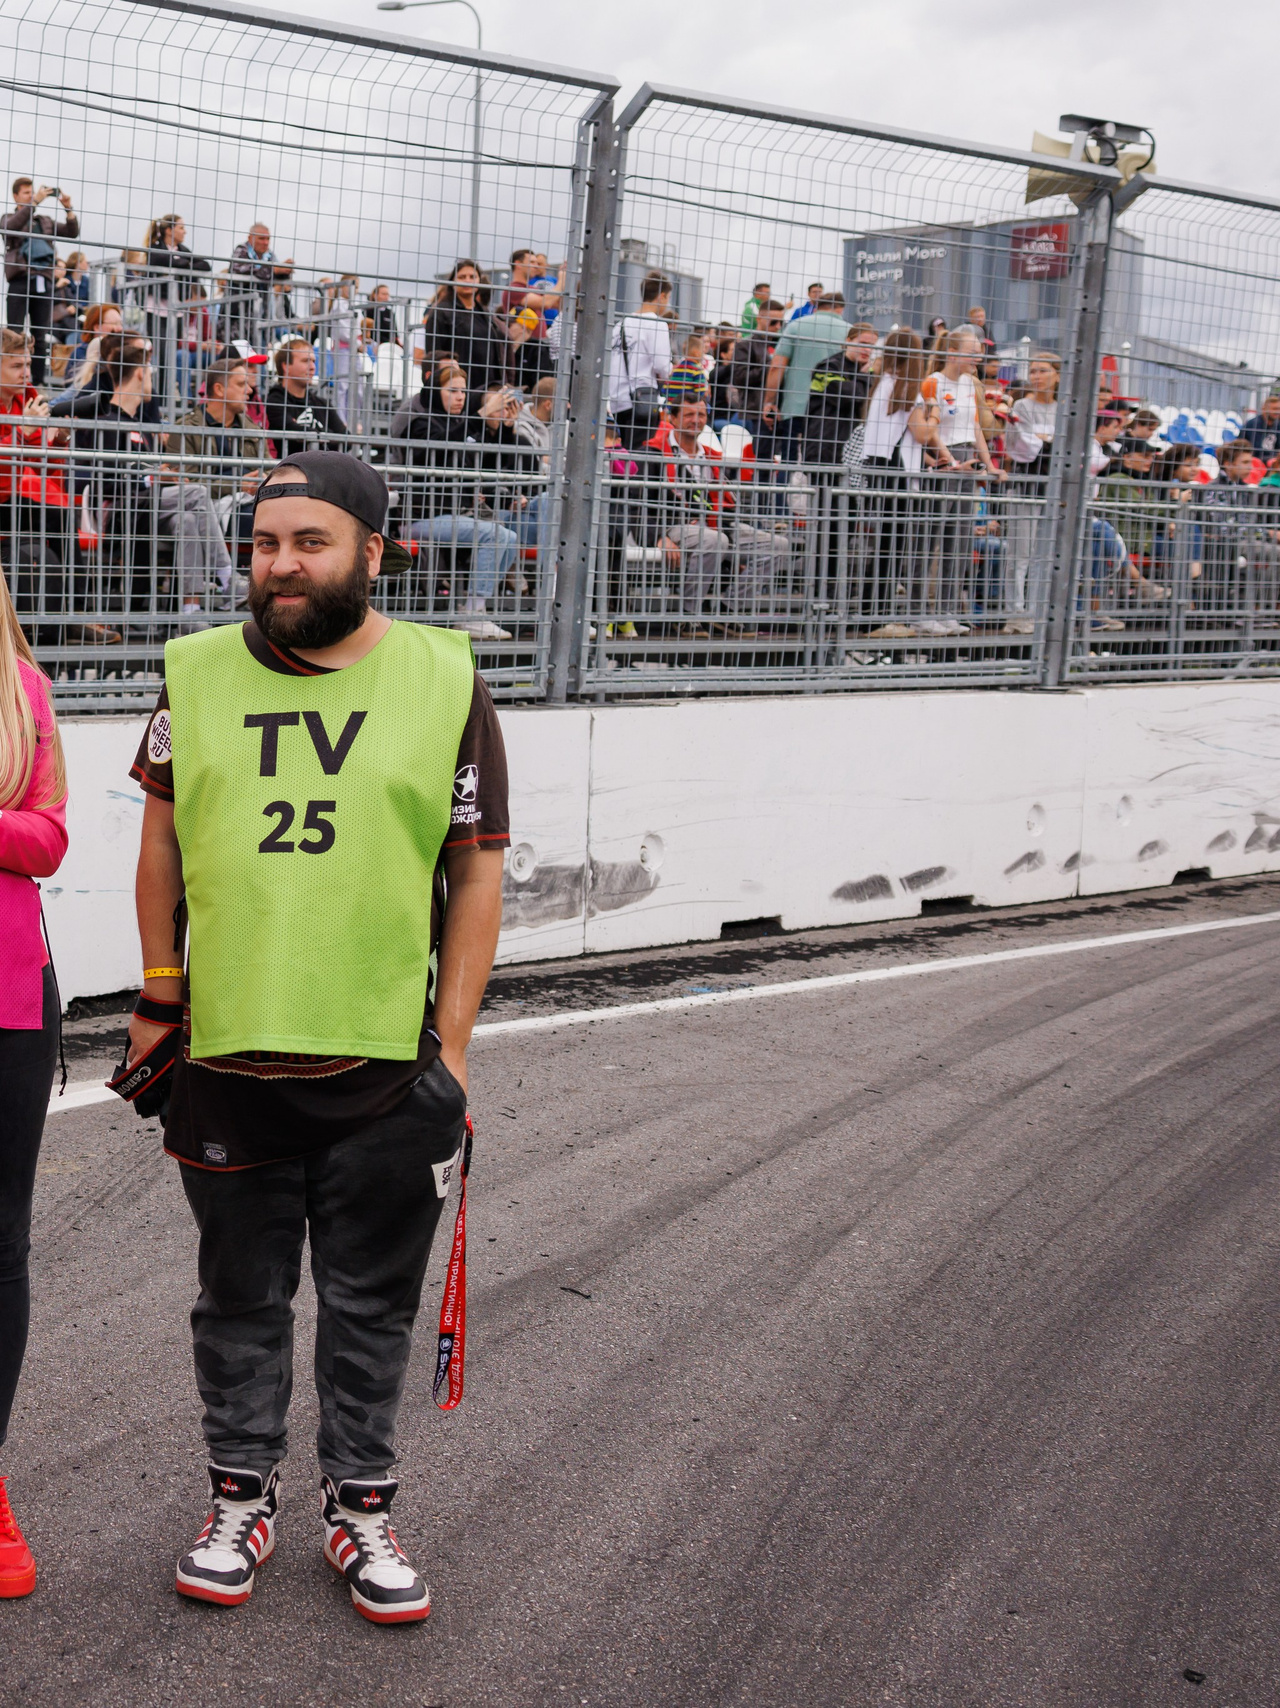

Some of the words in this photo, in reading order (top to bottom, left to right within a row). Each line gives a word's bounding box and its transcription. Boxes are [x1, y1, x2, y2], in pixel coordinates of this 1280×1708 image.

[856, 250, 901, 264] Ралли
[856, 267, 903, 282] Центр
[856, 287, 889, 302] Rally
[244, 710, 368, 777] TV
[258, 800, 336, 854] 25
[117, 1066, 151, 1095] Canon
[454, 1239, 463, 1259] ЭТО
[444, 1260, 459, 1326] ПРАКТИЧНО!
[452, 1340, 461, 1359] ЭТО
[453, 1386, 460, 1398] НЕ
